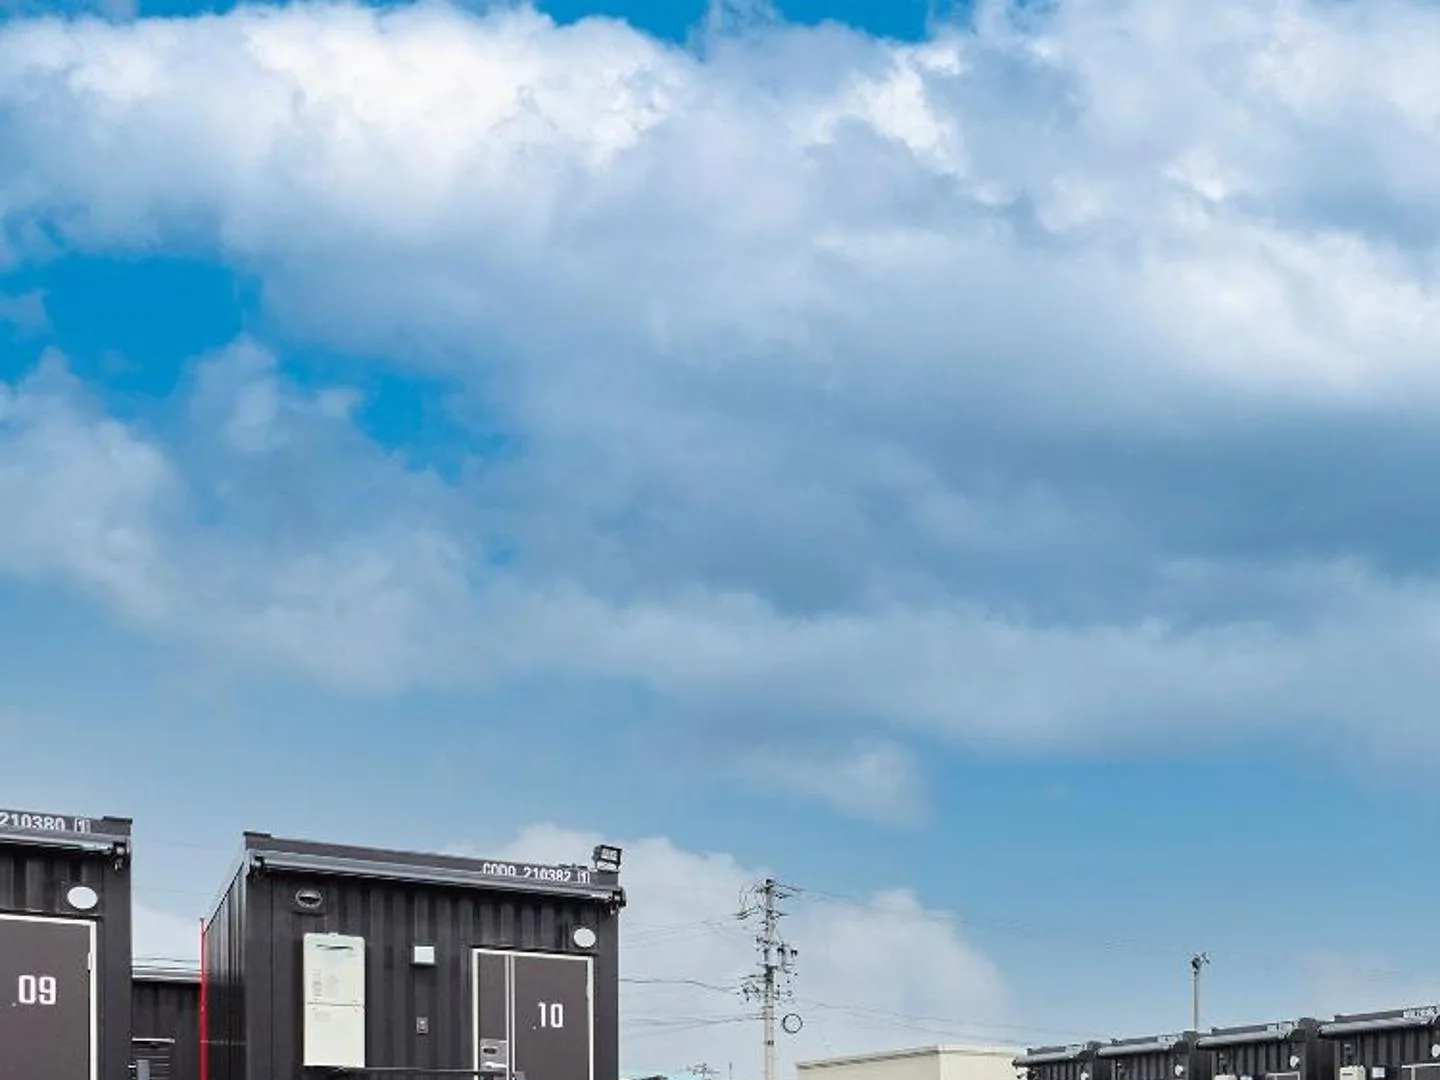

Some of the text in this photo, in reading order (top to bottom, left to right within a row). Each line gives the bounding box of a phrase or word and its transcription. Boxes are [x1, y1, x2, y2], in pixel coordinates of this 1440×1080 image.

[523, 867, 571, 882] 210382
[18, 975, 56, 1005] 09
[538, 1002, 563, 1028] 10
